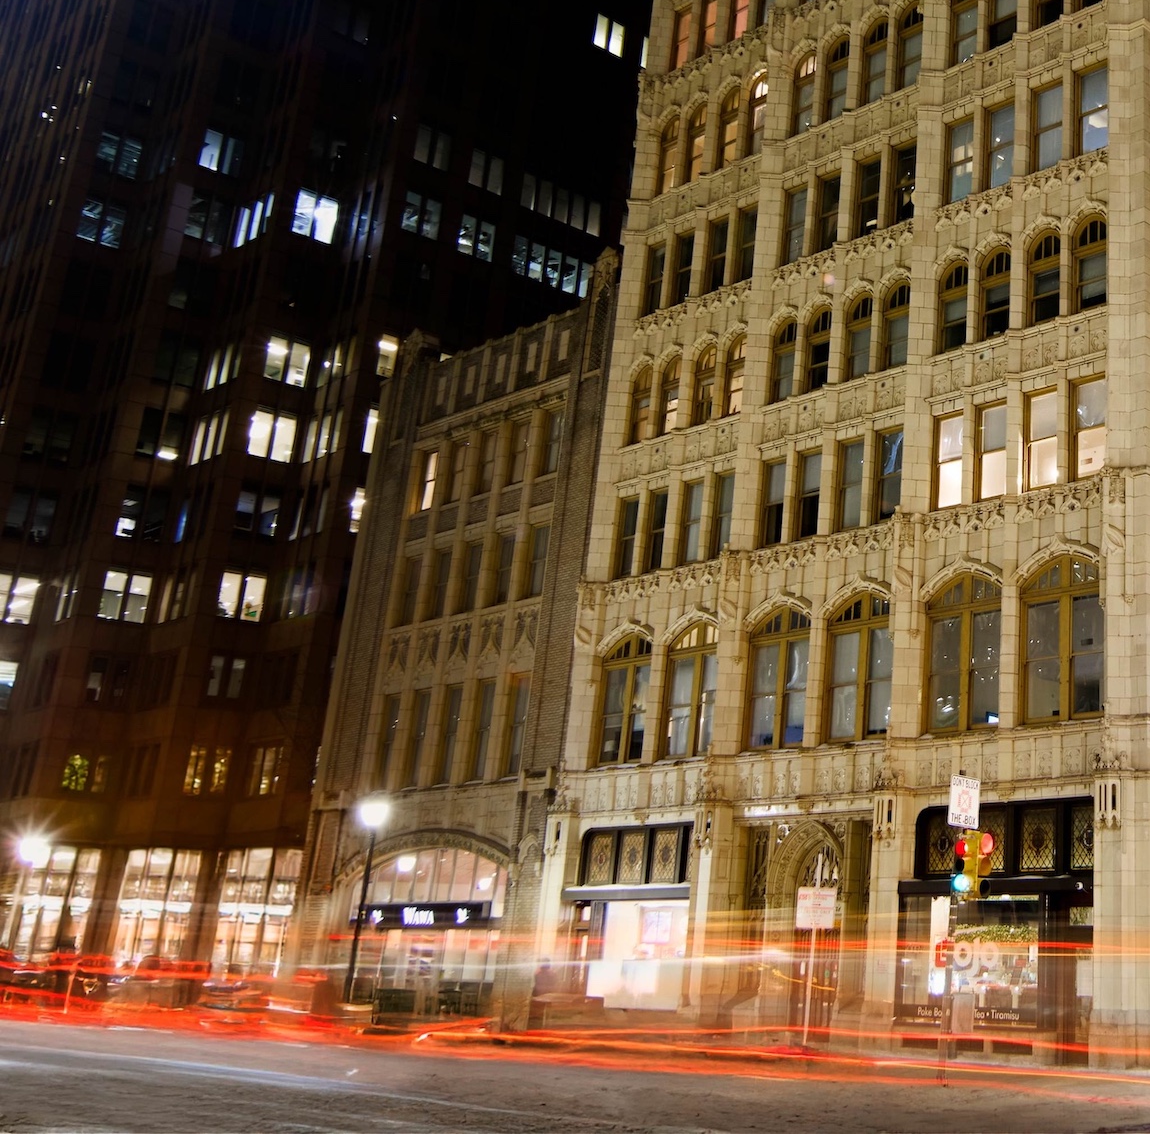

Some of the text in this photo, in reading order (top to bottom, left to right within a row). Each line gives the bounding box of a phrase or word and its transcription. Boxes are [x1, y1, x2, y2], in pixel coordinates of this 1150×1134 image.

[965, 780, 978, 790] BLOCK
[951, 813, 976, 825] THE BOX
[917, 1006, 932, 1017] Poke
[973, 1009, 985, 1018] Tea
[991, 1009, 1020, 1021] Tiramisu
